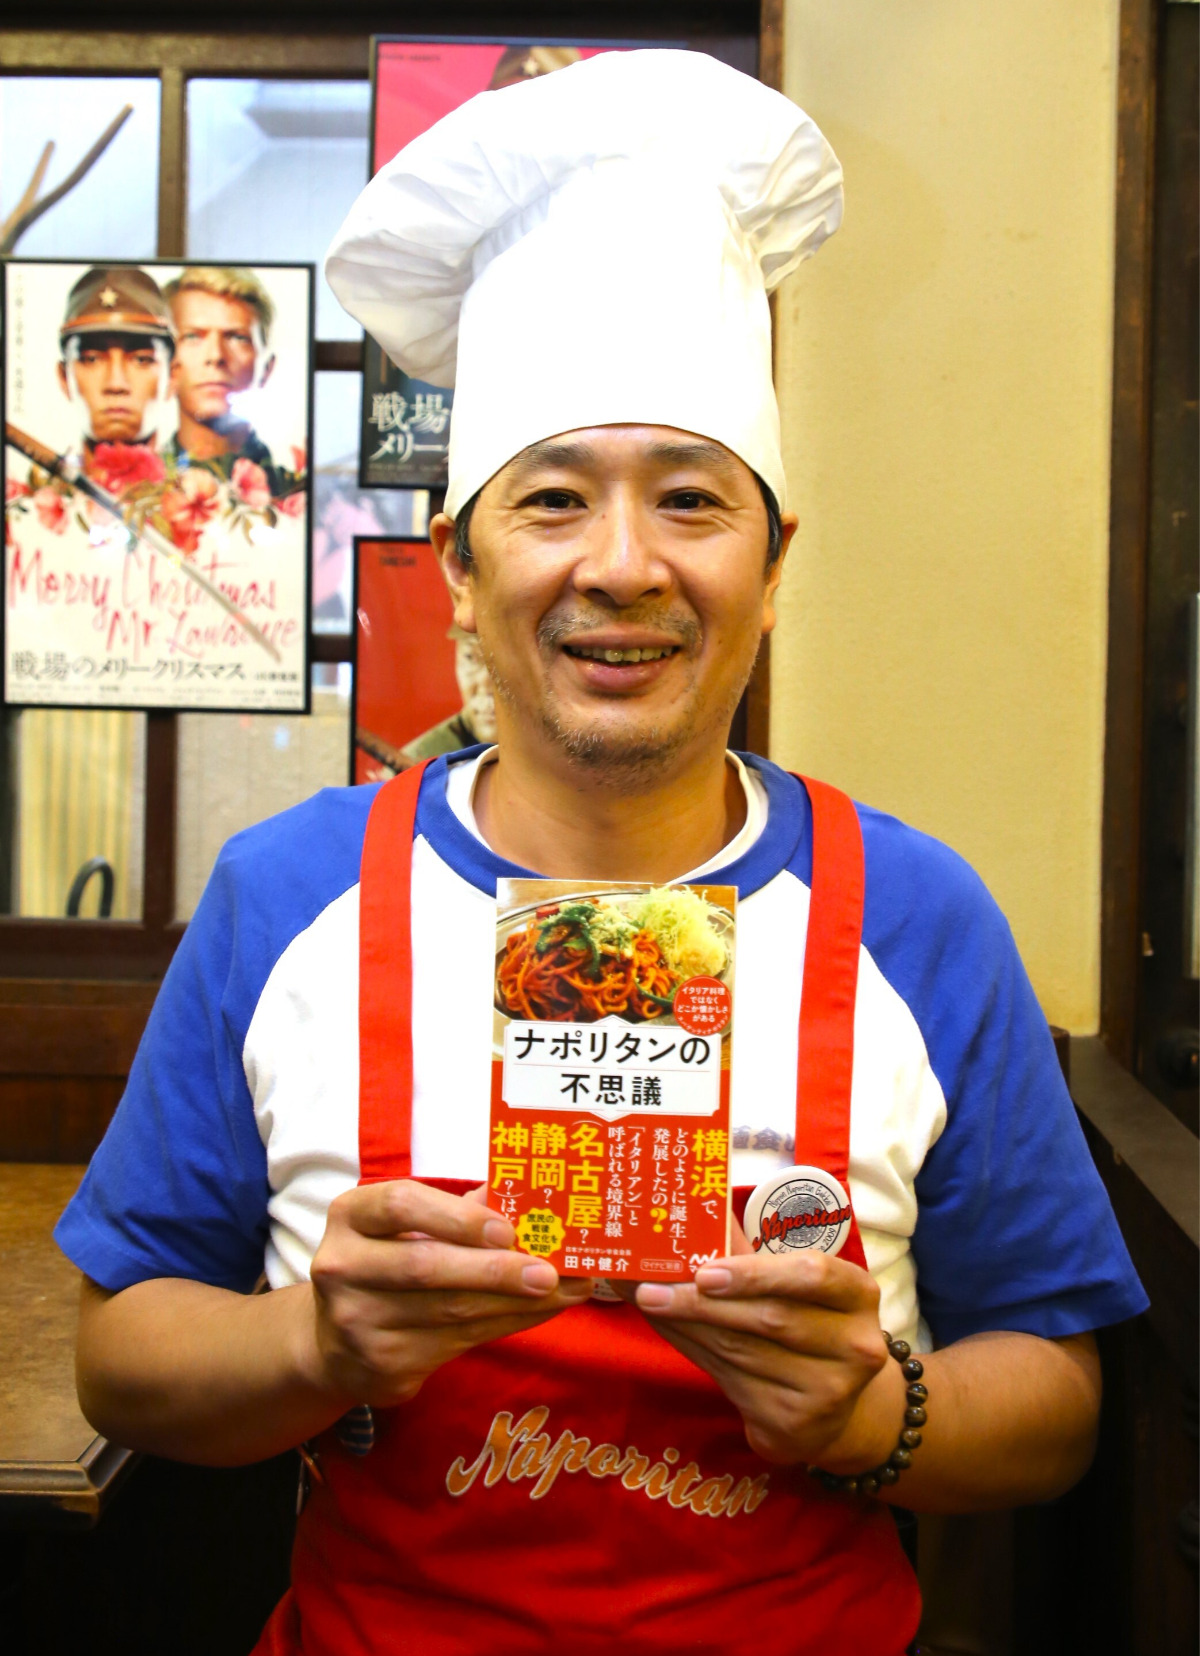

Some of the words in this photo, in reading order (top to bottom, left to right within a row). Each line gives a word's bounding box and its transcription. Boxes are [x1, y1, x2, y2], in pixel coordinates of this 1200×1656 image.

[367, 391, 450, 434] 戦場
[368, 433, 449, 464] メリー
[9, 545, 110, 632] Merry
[12, 650, 246, 681] 戦場のメリークリスマス
[682, 986, 726, 996] イタリア料理
[690, 996, 719, 1005] ではなく
[677, 1004, 728, 1014] どこか懐かしさ
[692, 1014, 716, 1023] がある
[514, 1029, 710, 1065] ナポリタンの
[560, 1073, 662, 1106] 不思議
[604, 1126, 626, 1238] 呼ばれる境界線
[624, 1126, 646, 1226] 「イタリアン」と
[690, 1128, 728, 1219] 横浜で、
[669, 1128, 689, 1260] どのように誕生し、
[523, 1232, 558, 1244] 食文化を
[752, 1204, 851, 1253] Naporitan
[823, 1227, 837, 1246] 2009
[564, 1255, 629, 1272] 田中健介
[446, 1405, 770, 1518] Naporitan
